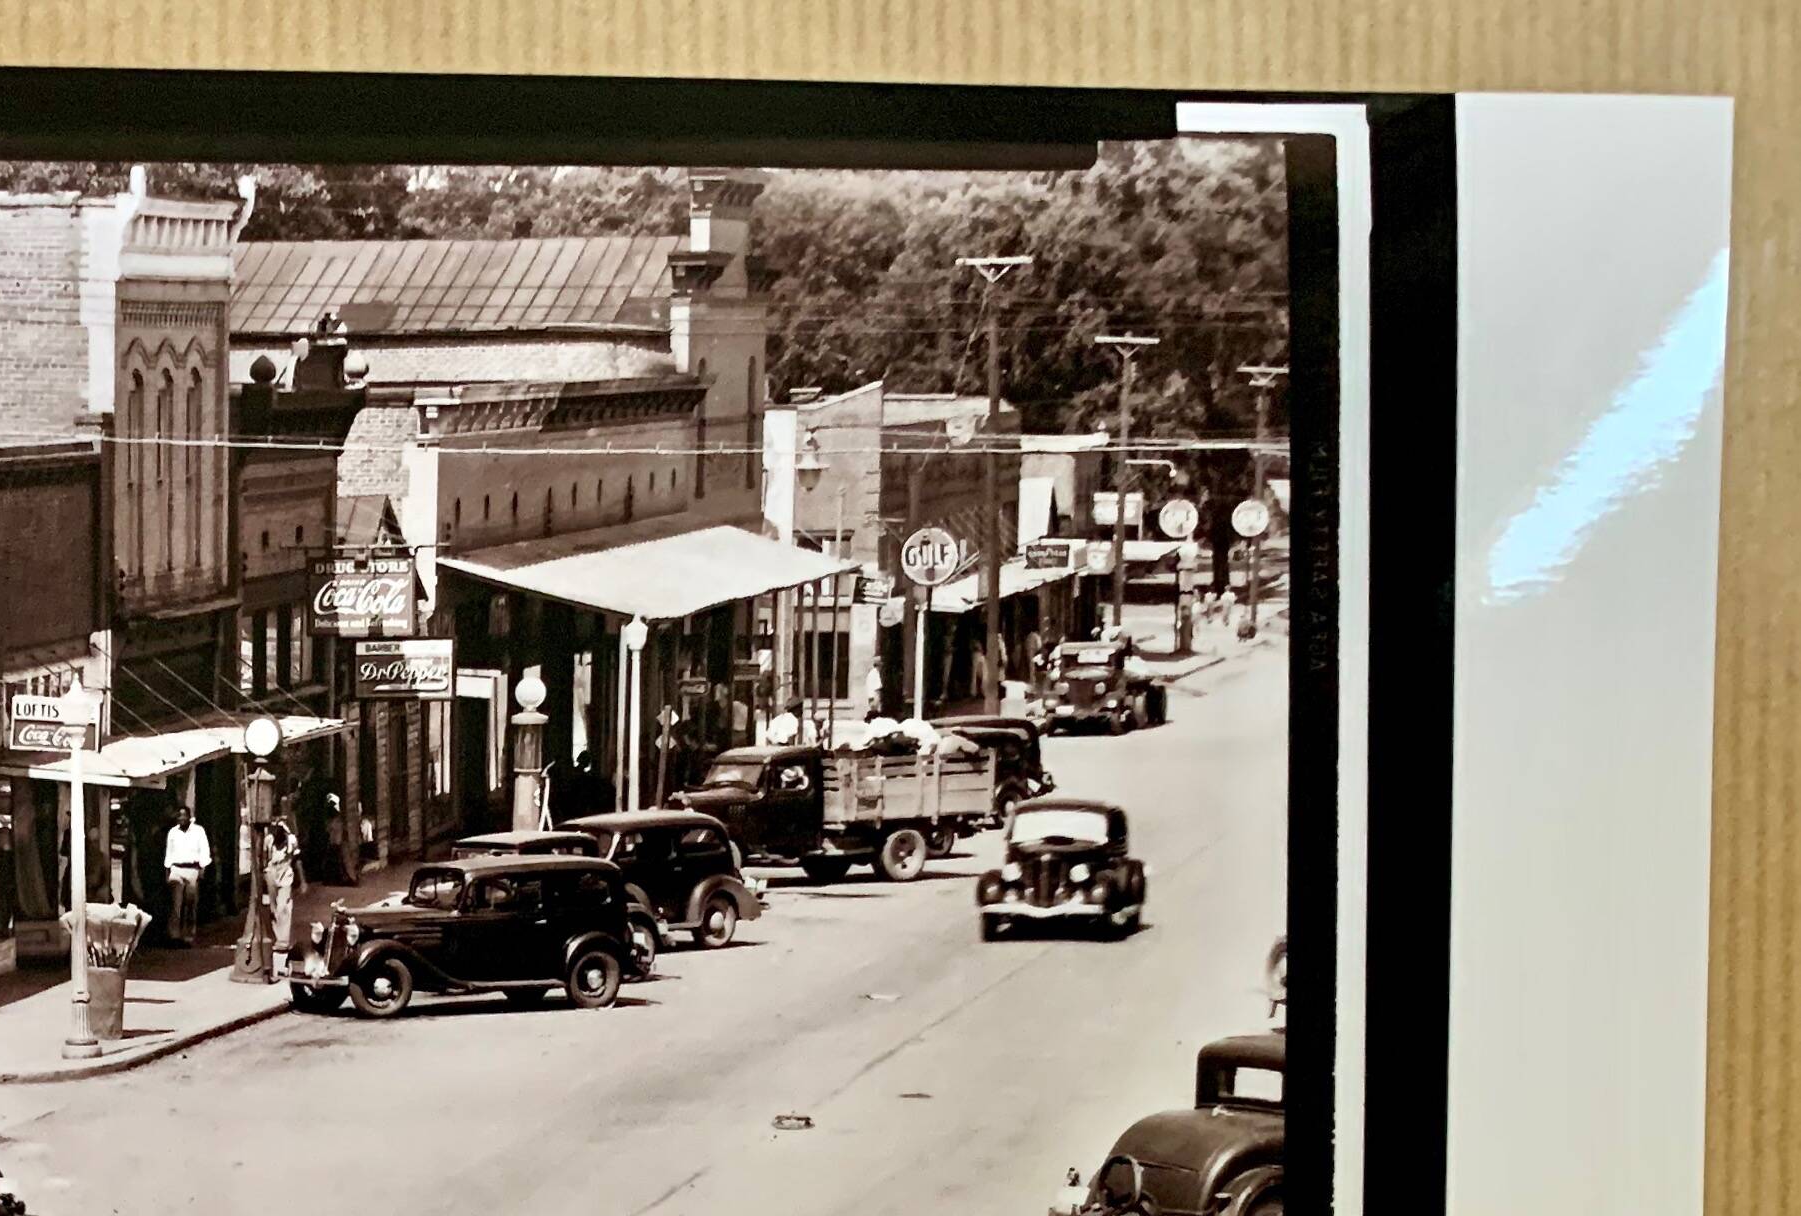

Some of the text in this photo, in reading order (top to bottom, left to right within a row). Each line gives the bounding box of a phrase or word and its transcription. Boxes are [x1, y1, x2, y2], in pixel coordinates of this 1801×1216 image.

[905, 541, 950, 567] GULF
[315, 562, 355, 574] DRUG
[314, 578, 410, 615] Coca-Cola
[365, 644, 400, 653] BARBER
[15, 703, 59, 718] LOFTIS
